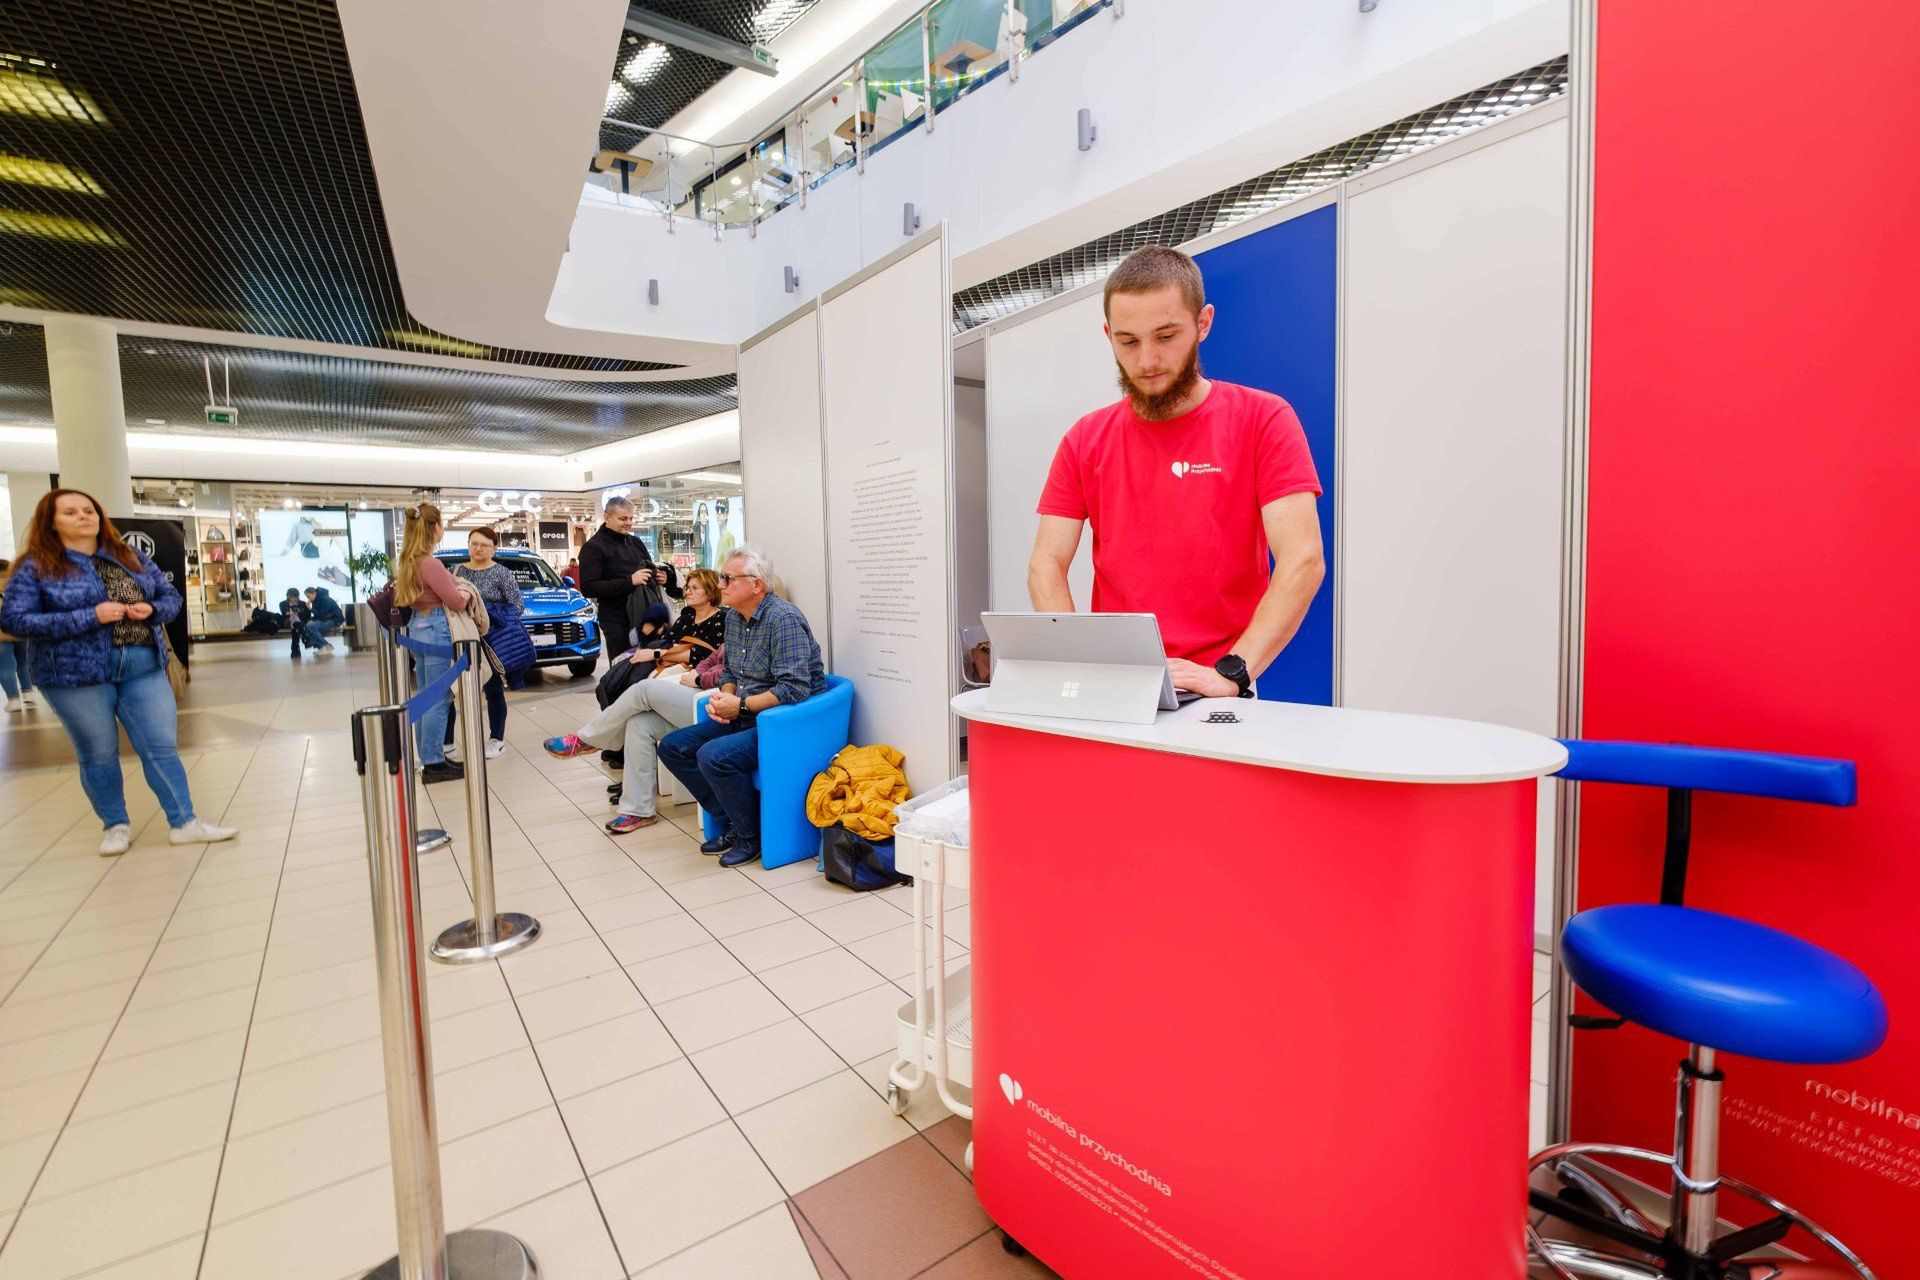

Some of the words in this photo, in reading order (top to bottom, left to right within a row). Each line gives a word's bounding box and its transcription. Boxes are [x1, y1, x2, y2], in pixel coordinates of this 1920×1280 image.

[478, 490, 542, 512] CCC
[542, 532, 566, 540] crocs
[1805, 1079, 1920, 1130] mobilna
[1027, 1099, 1077, 1138] mobilna
[1079, 1133, 1172, 1197] przychodnia
